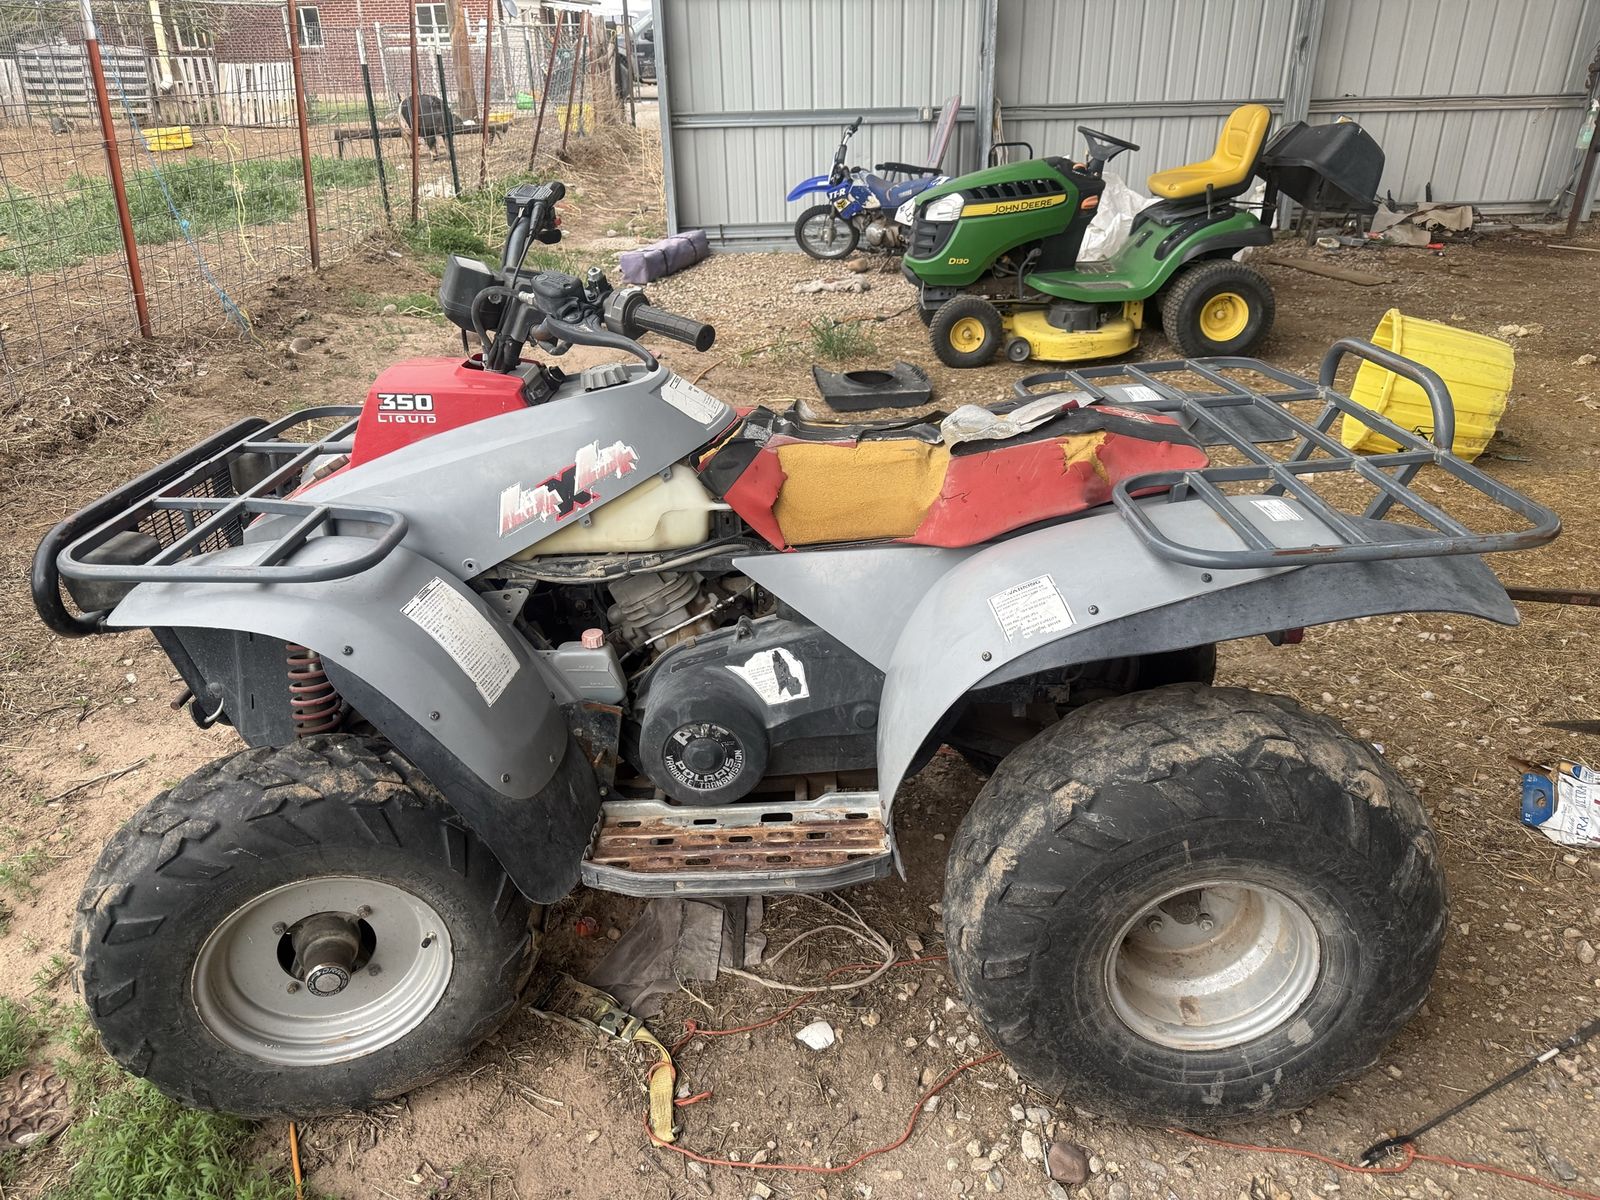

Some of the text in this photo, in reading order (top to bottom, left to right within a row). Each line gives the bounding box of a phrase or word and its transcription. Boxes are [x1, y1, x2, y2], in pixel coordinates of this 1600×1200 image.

[993, 199, 1053, 214] JOHN DEERE
[948, 257, 969, 265] D130
[377, 393, 434, 411] 350
[377, 414, 437, 424] LIQUID
[665, 749, 743, 789] VARIABLE TRANSMISSION
[675, 757, 734, 782] POLARIS
[1575, 816, 1590, 845] UTRA
